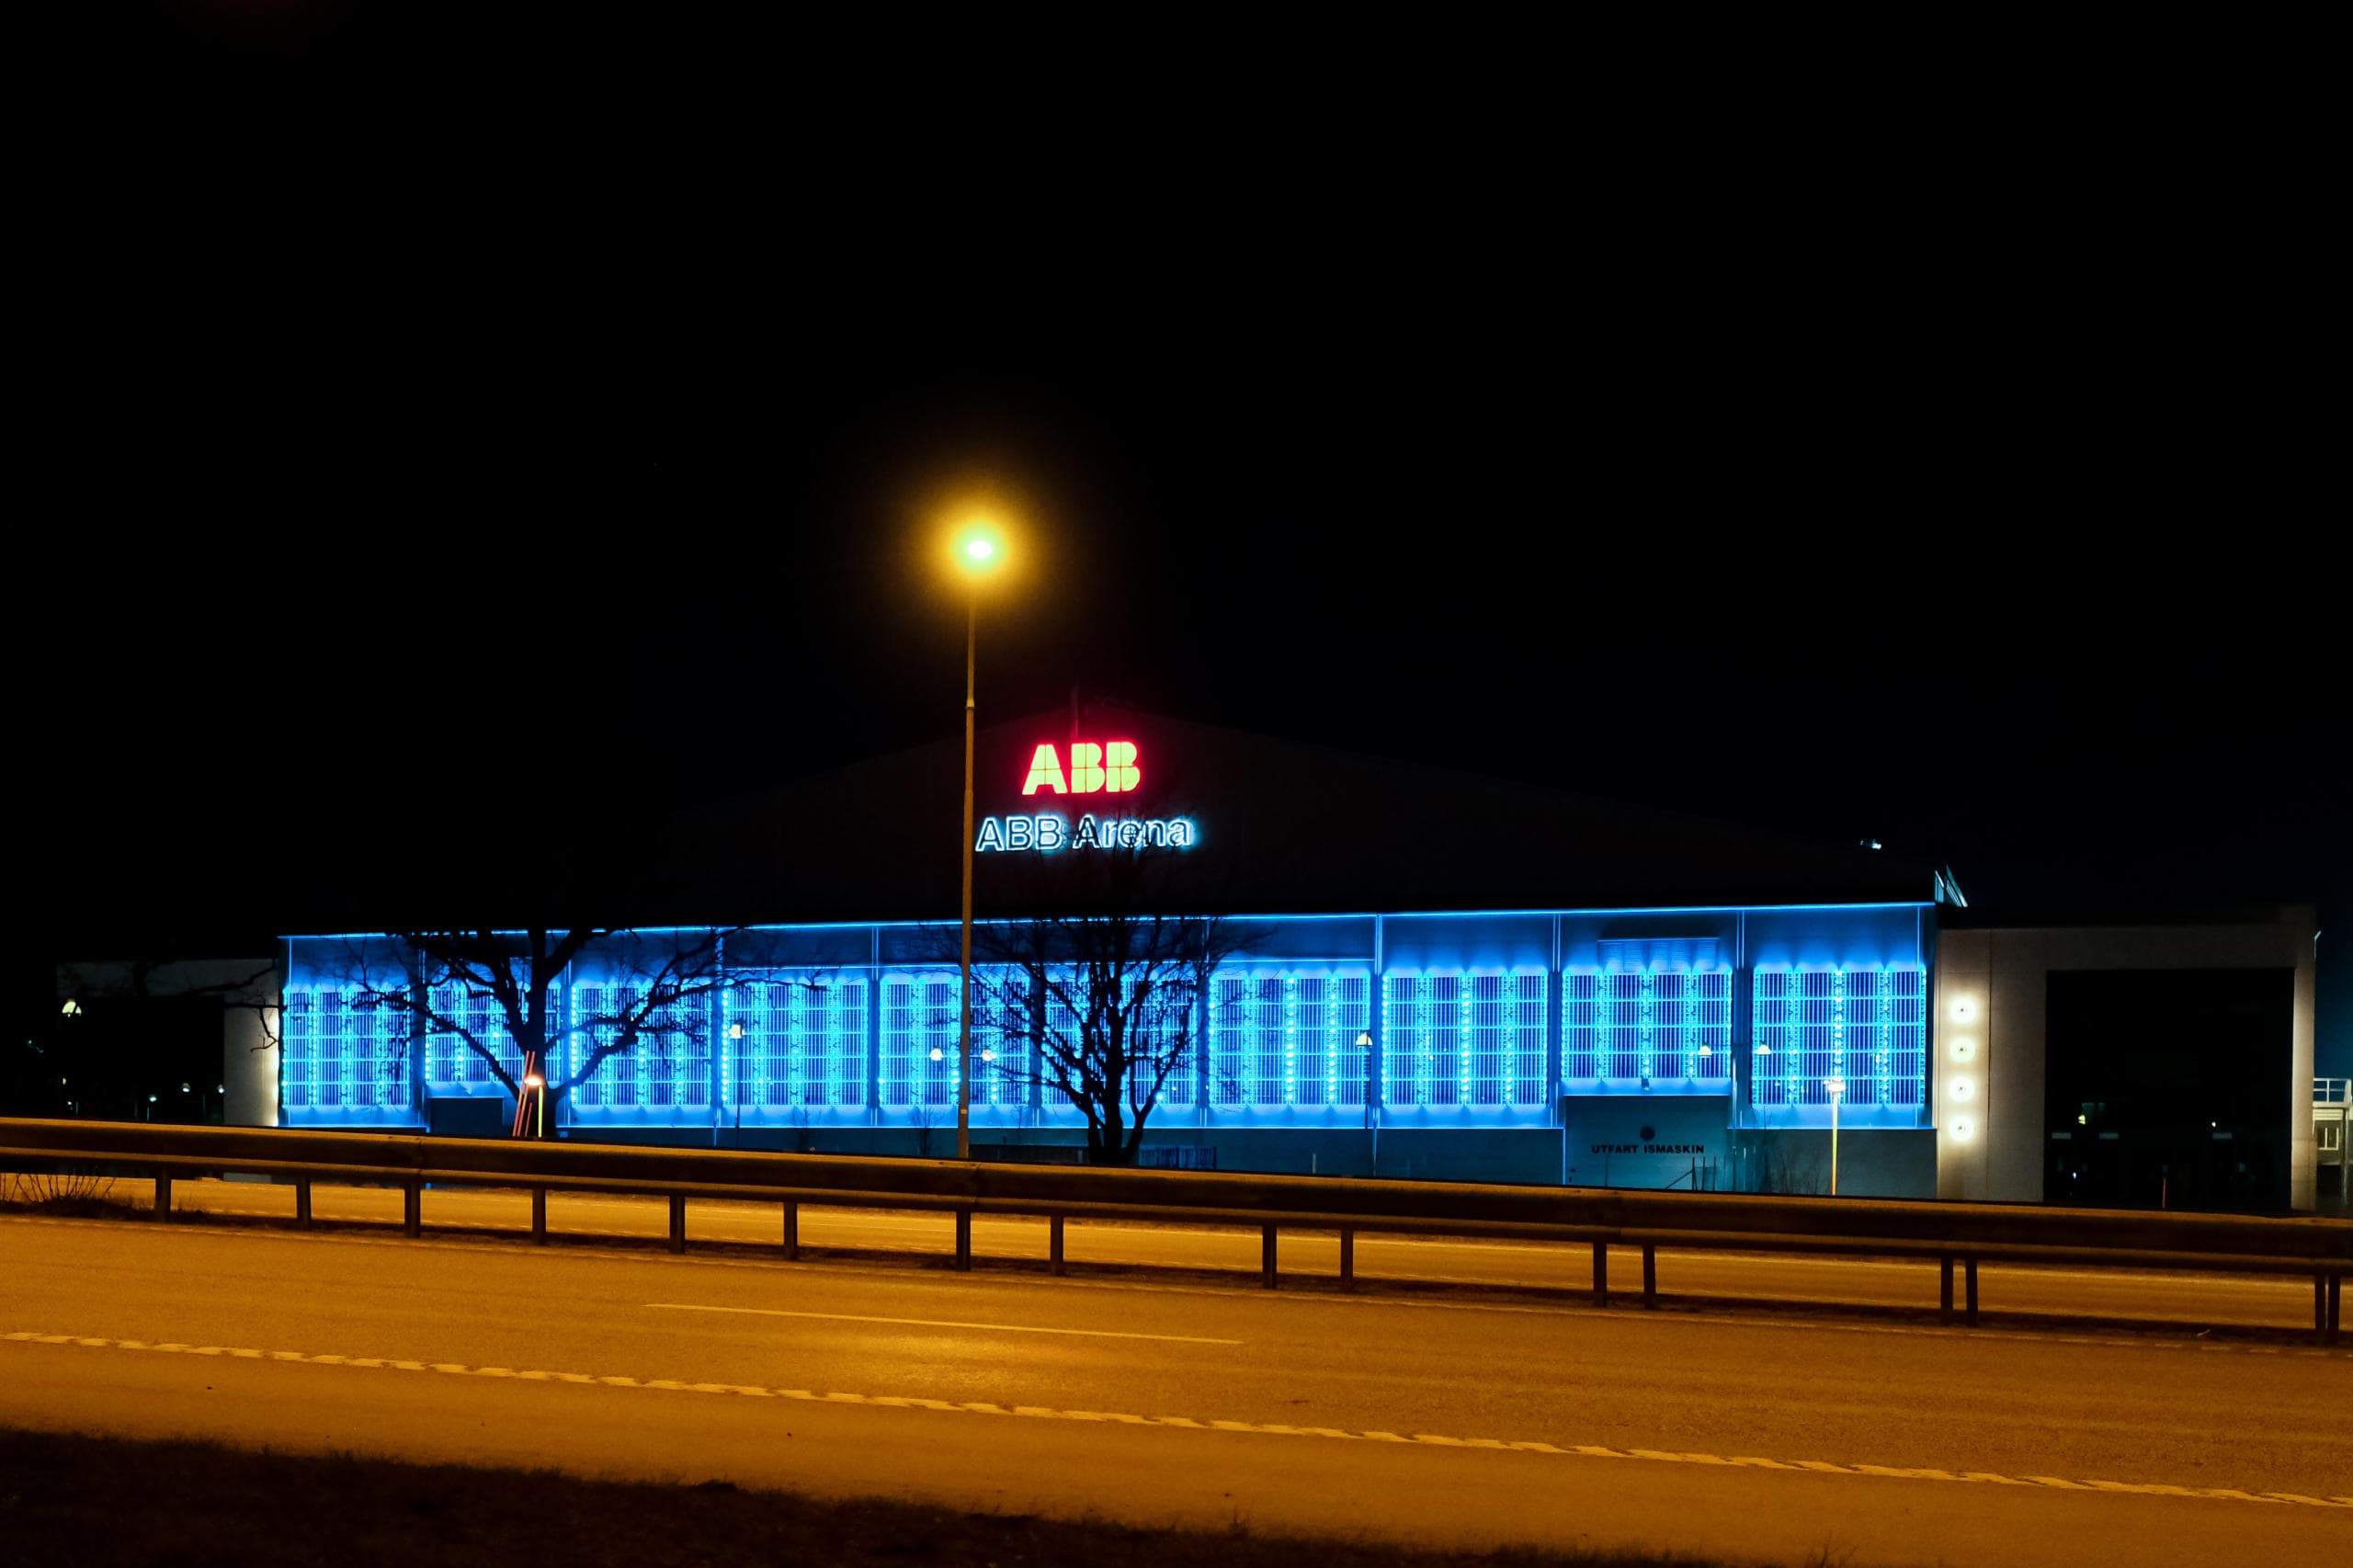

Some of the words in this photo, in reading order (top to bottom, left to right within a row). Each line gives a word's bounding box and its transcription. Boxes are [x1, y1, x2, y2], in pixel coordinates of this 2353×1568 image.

[1021, 741, 1141, 795] ABB
[975, 814, 1063, 851] ABB
[1072, 813, 1192, 848] Arena
[1591, 1144, 1639, 1153] UTFART
[1643, 1144, 1705, 1153] ISMASKIN
